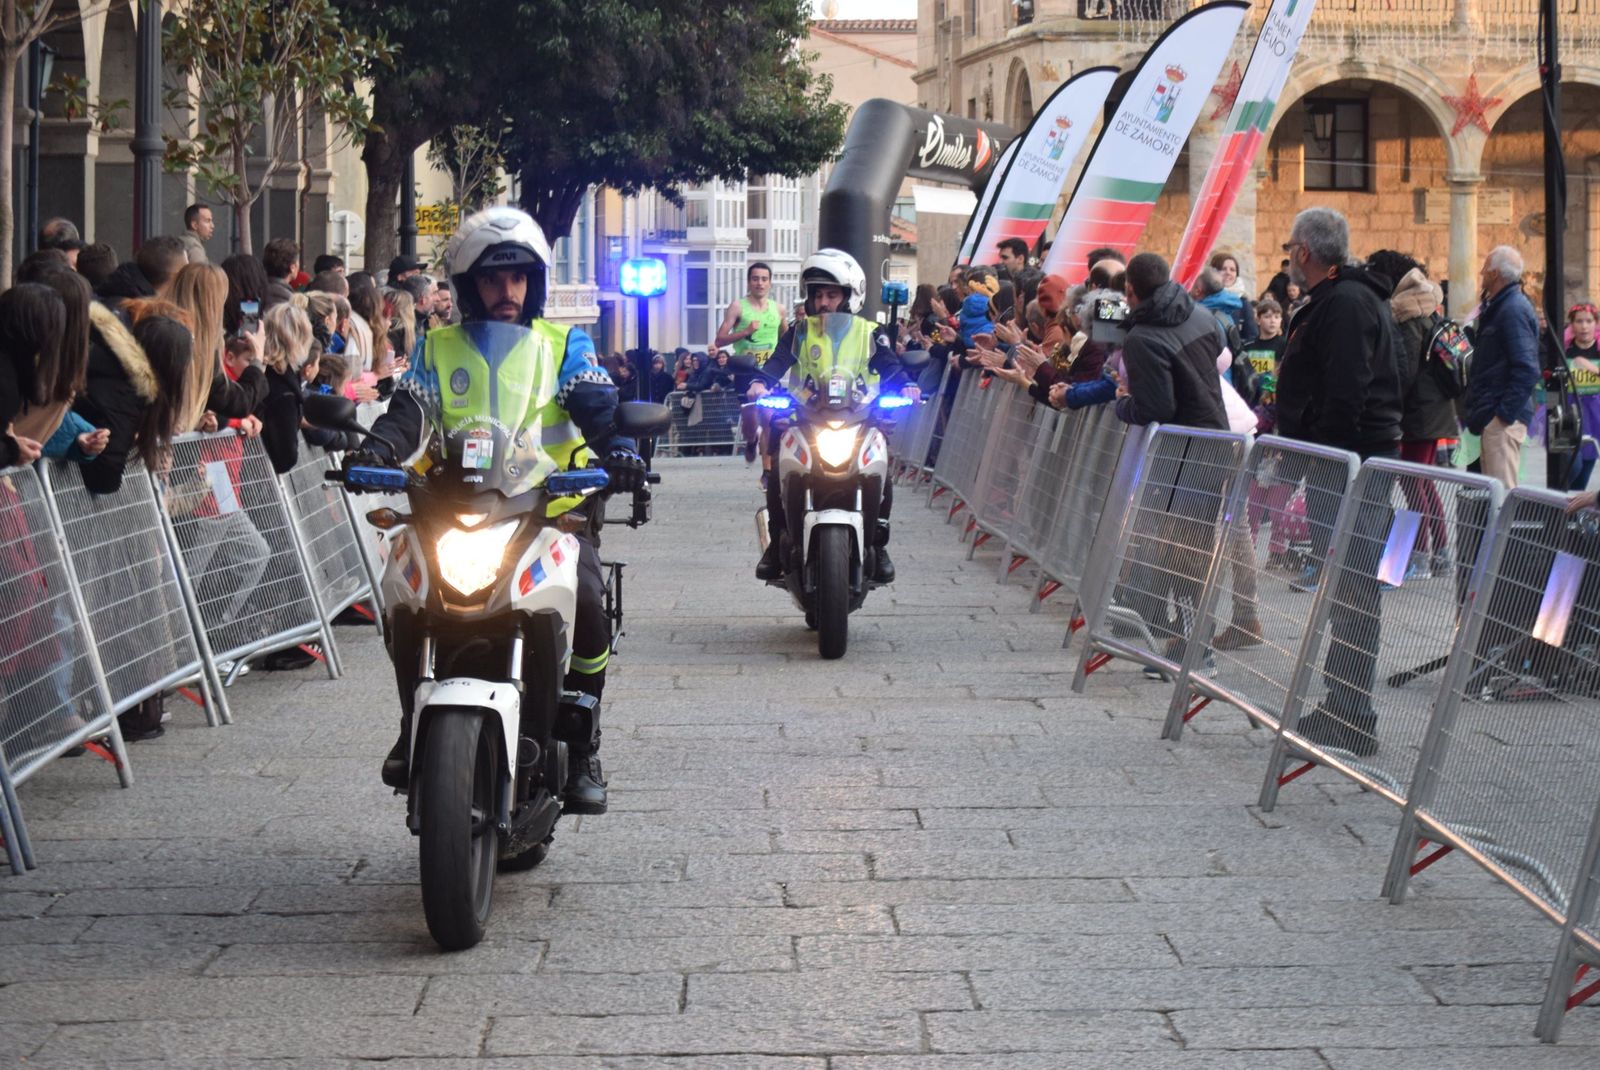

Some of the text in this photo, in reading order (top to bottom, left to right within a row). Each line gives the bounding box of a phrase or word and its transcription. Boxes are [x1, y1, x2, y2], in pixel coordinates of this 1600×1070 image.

[1114, 120, 1175, 158] DE ZAMORA
[1121, 111, 1181, 146] AYUNTAMIENTO
[474, 414, 513, 440] MUNICIPAL
